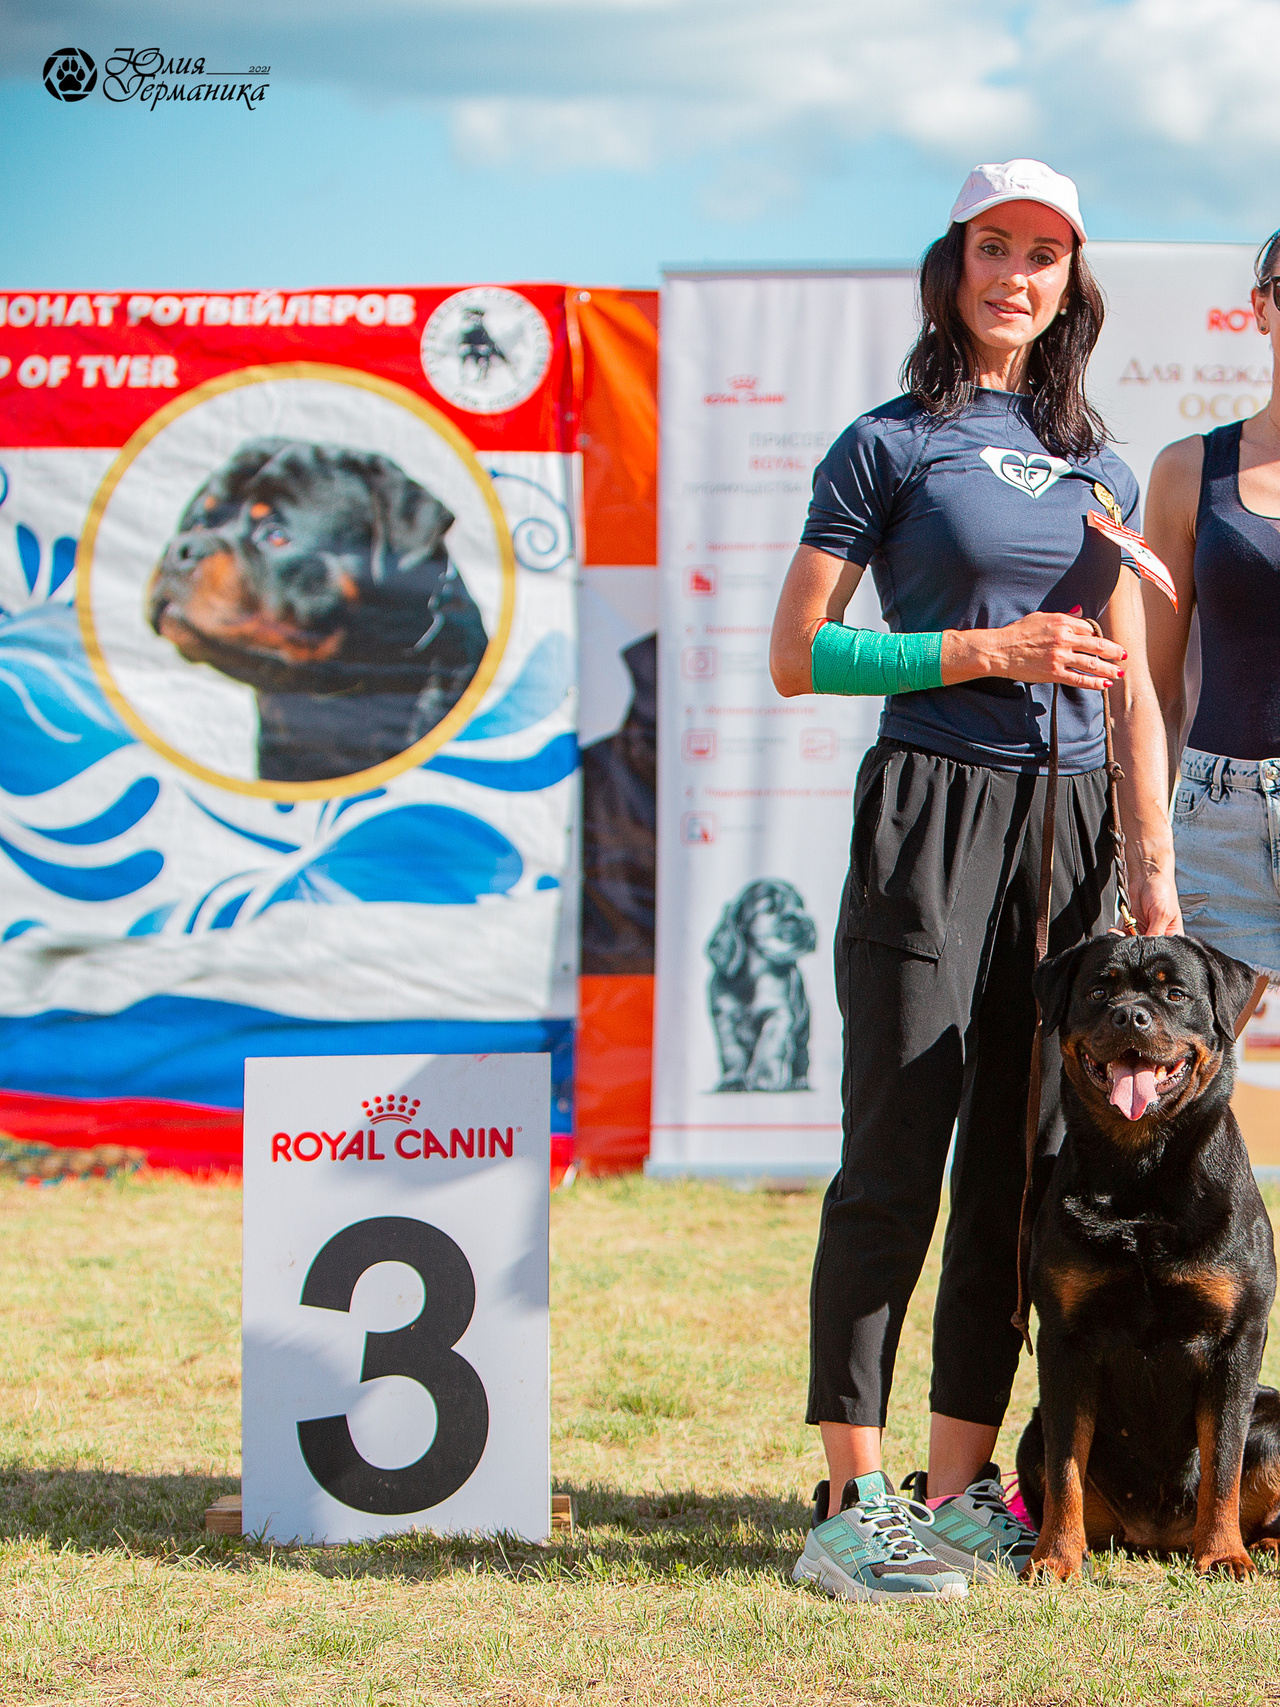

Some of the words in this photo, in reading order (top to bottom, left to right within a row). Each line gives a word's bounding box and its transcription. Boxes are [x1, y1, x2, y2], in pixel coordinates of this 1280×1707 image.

[0, 294, 120, 328] ОНАТ
[127, 289, 416, 327] РОТВЕЙЛЕРОВ
[16, 354, 71, 389] OF
[76, 354, 180, 389] TVER
[1118, 356, 1181, 386] Для
[1193, 363, 1273, 386] кажд
[271, 1129, 385, 1163] ROYAL
[296, 1215, 490, 1515] 3
